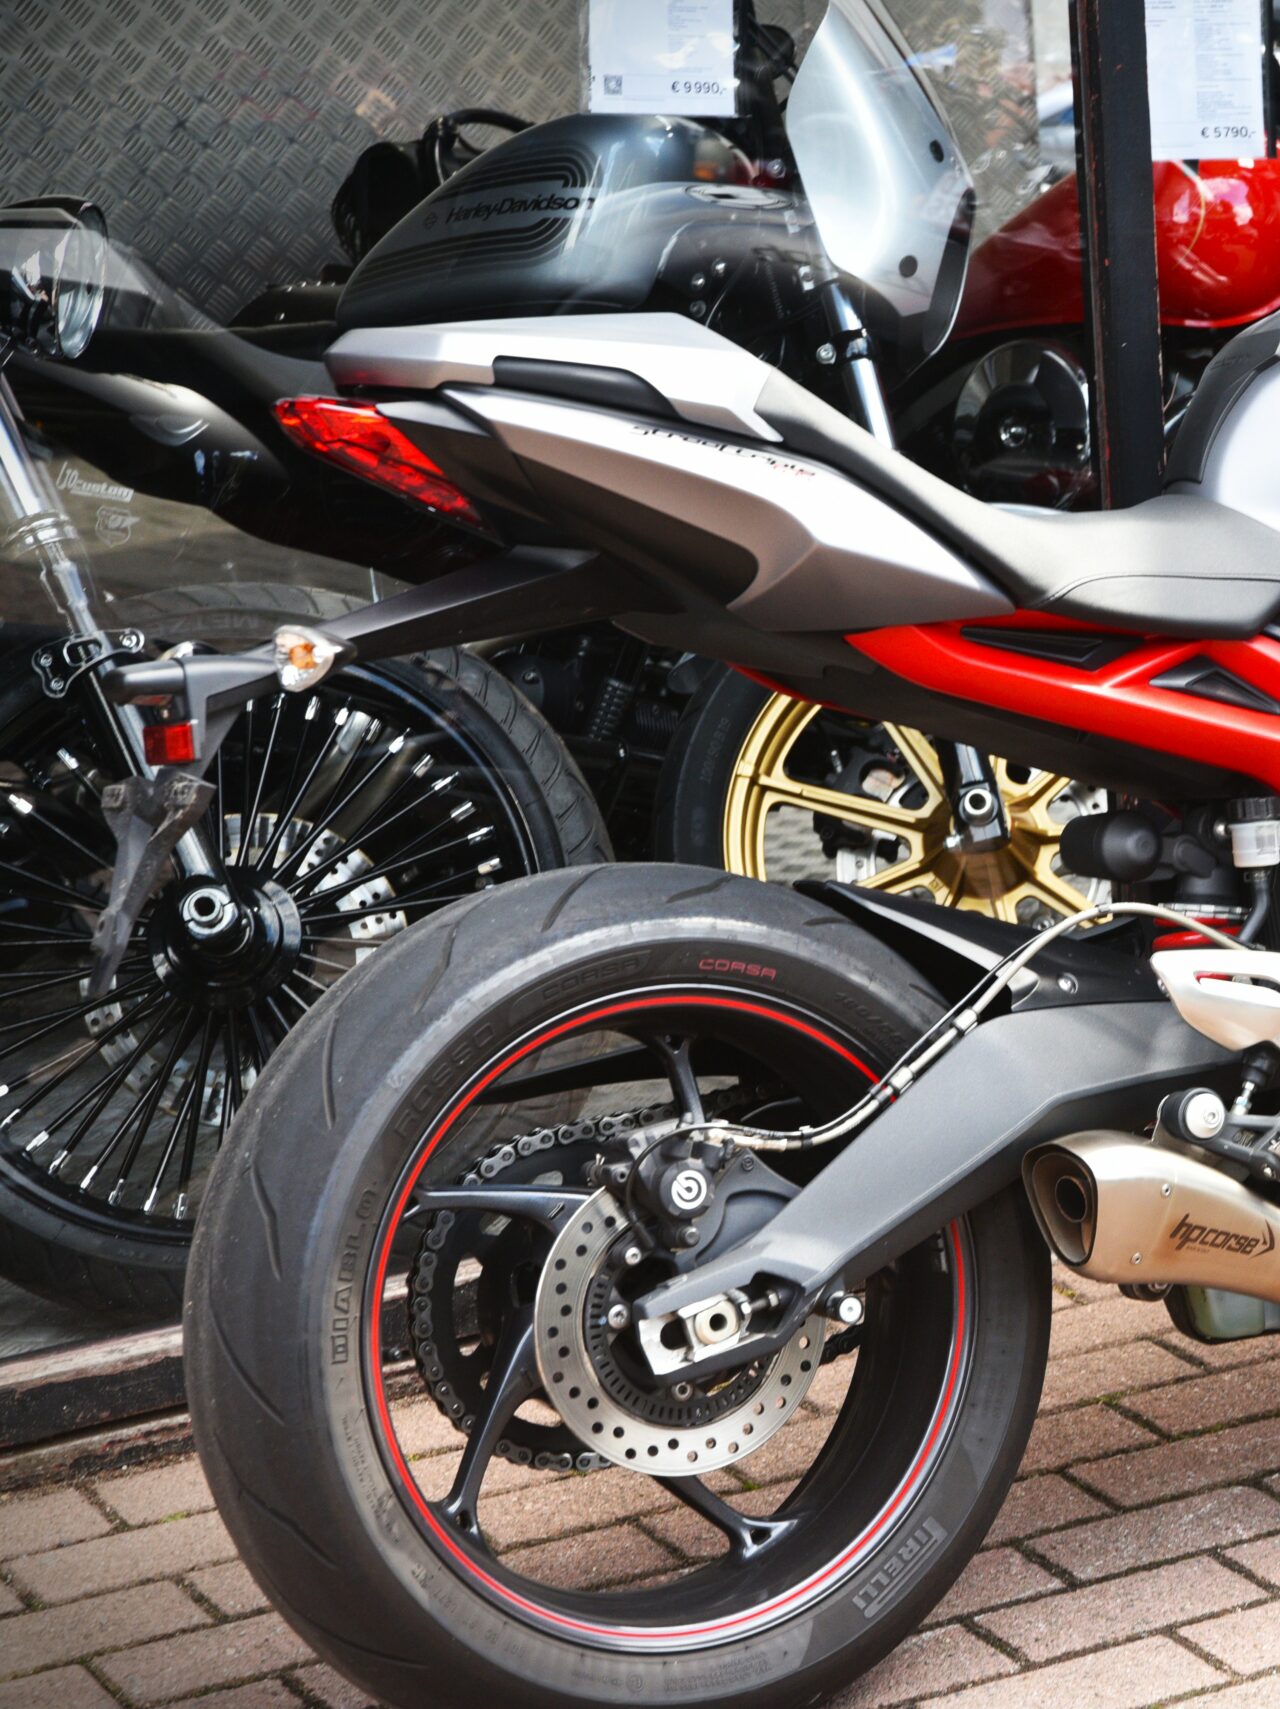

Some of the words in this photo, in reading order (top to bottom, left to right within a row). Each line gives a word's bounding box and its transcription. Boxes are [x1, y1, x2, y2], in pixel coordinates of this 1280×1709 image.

[540, 956, 641, 1001] CORSA
[698, 958, 777, 980] CORSA
[851, 1515, 948, 1619] PIRELLI
